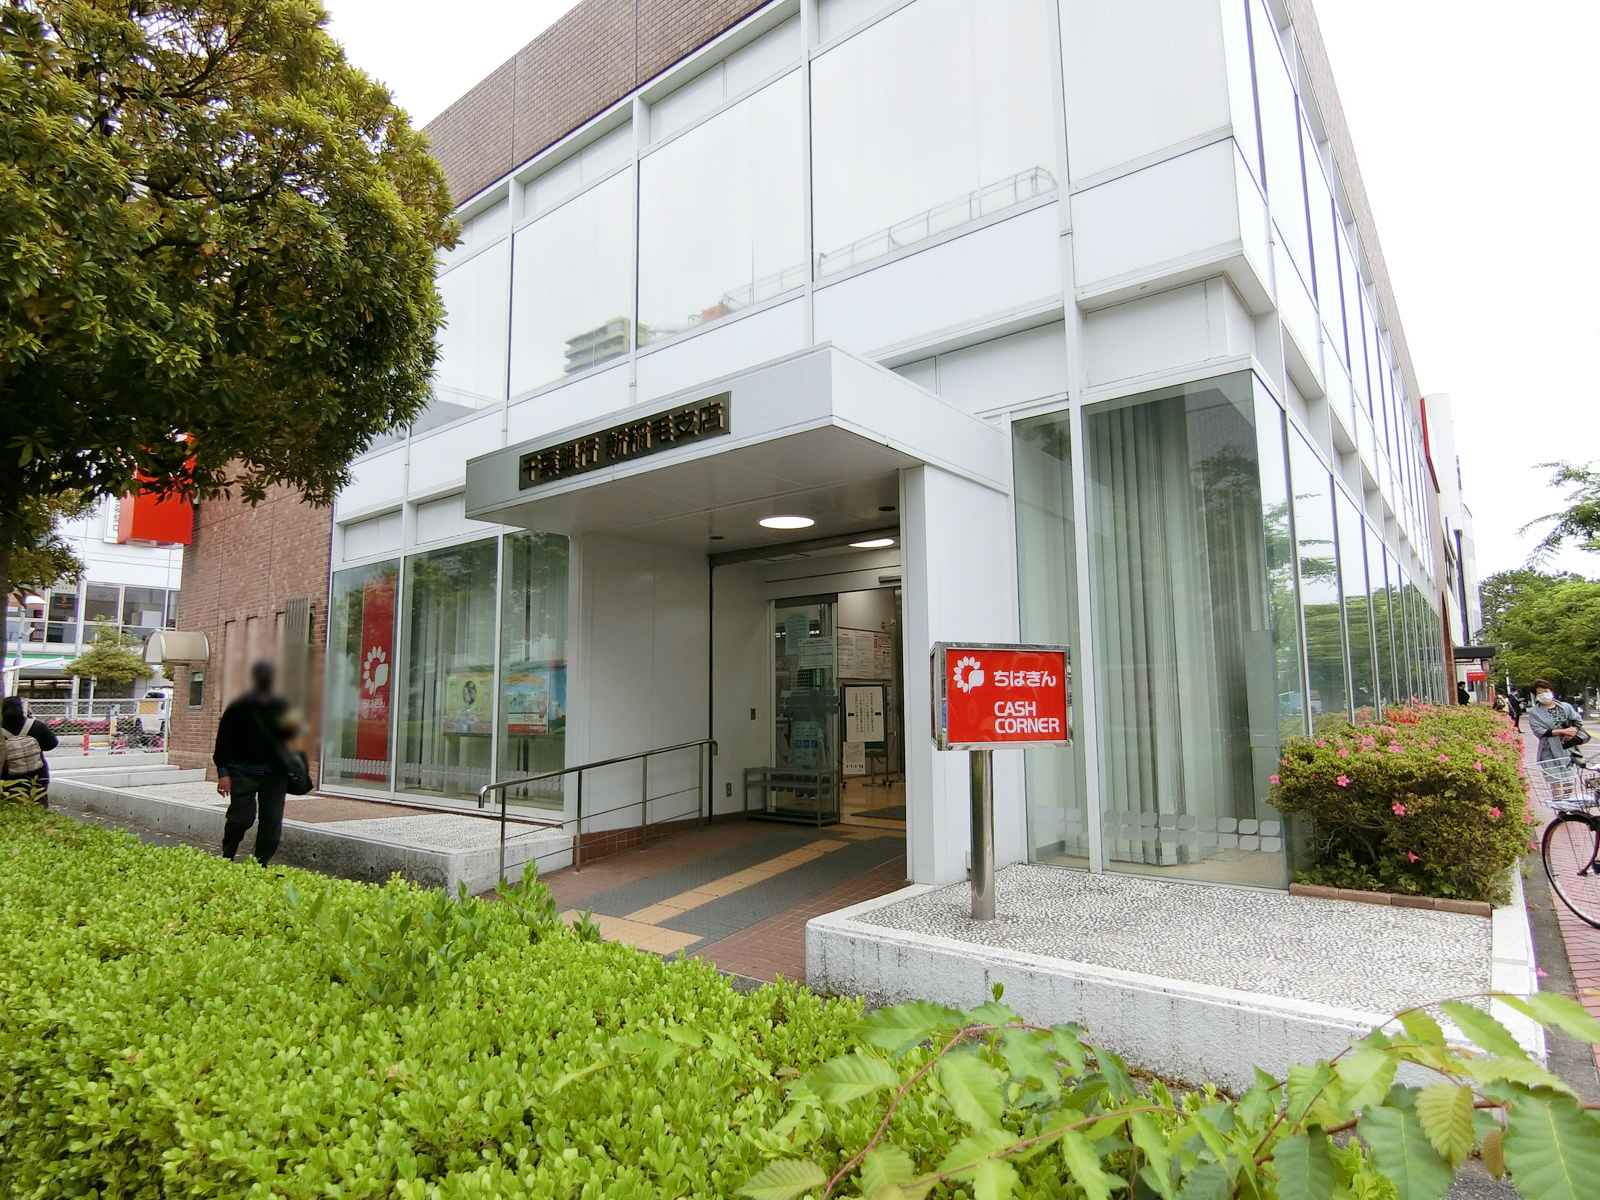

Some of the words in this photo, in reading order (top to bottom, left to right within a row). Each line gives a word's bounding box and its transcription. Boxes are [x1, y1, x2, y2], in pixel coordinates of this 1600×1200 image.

[993, 670, 1056, 687] ちばぎん
[995, 700, 1036, 716] CASH
[995, 718, 1059, 733] CORNER
